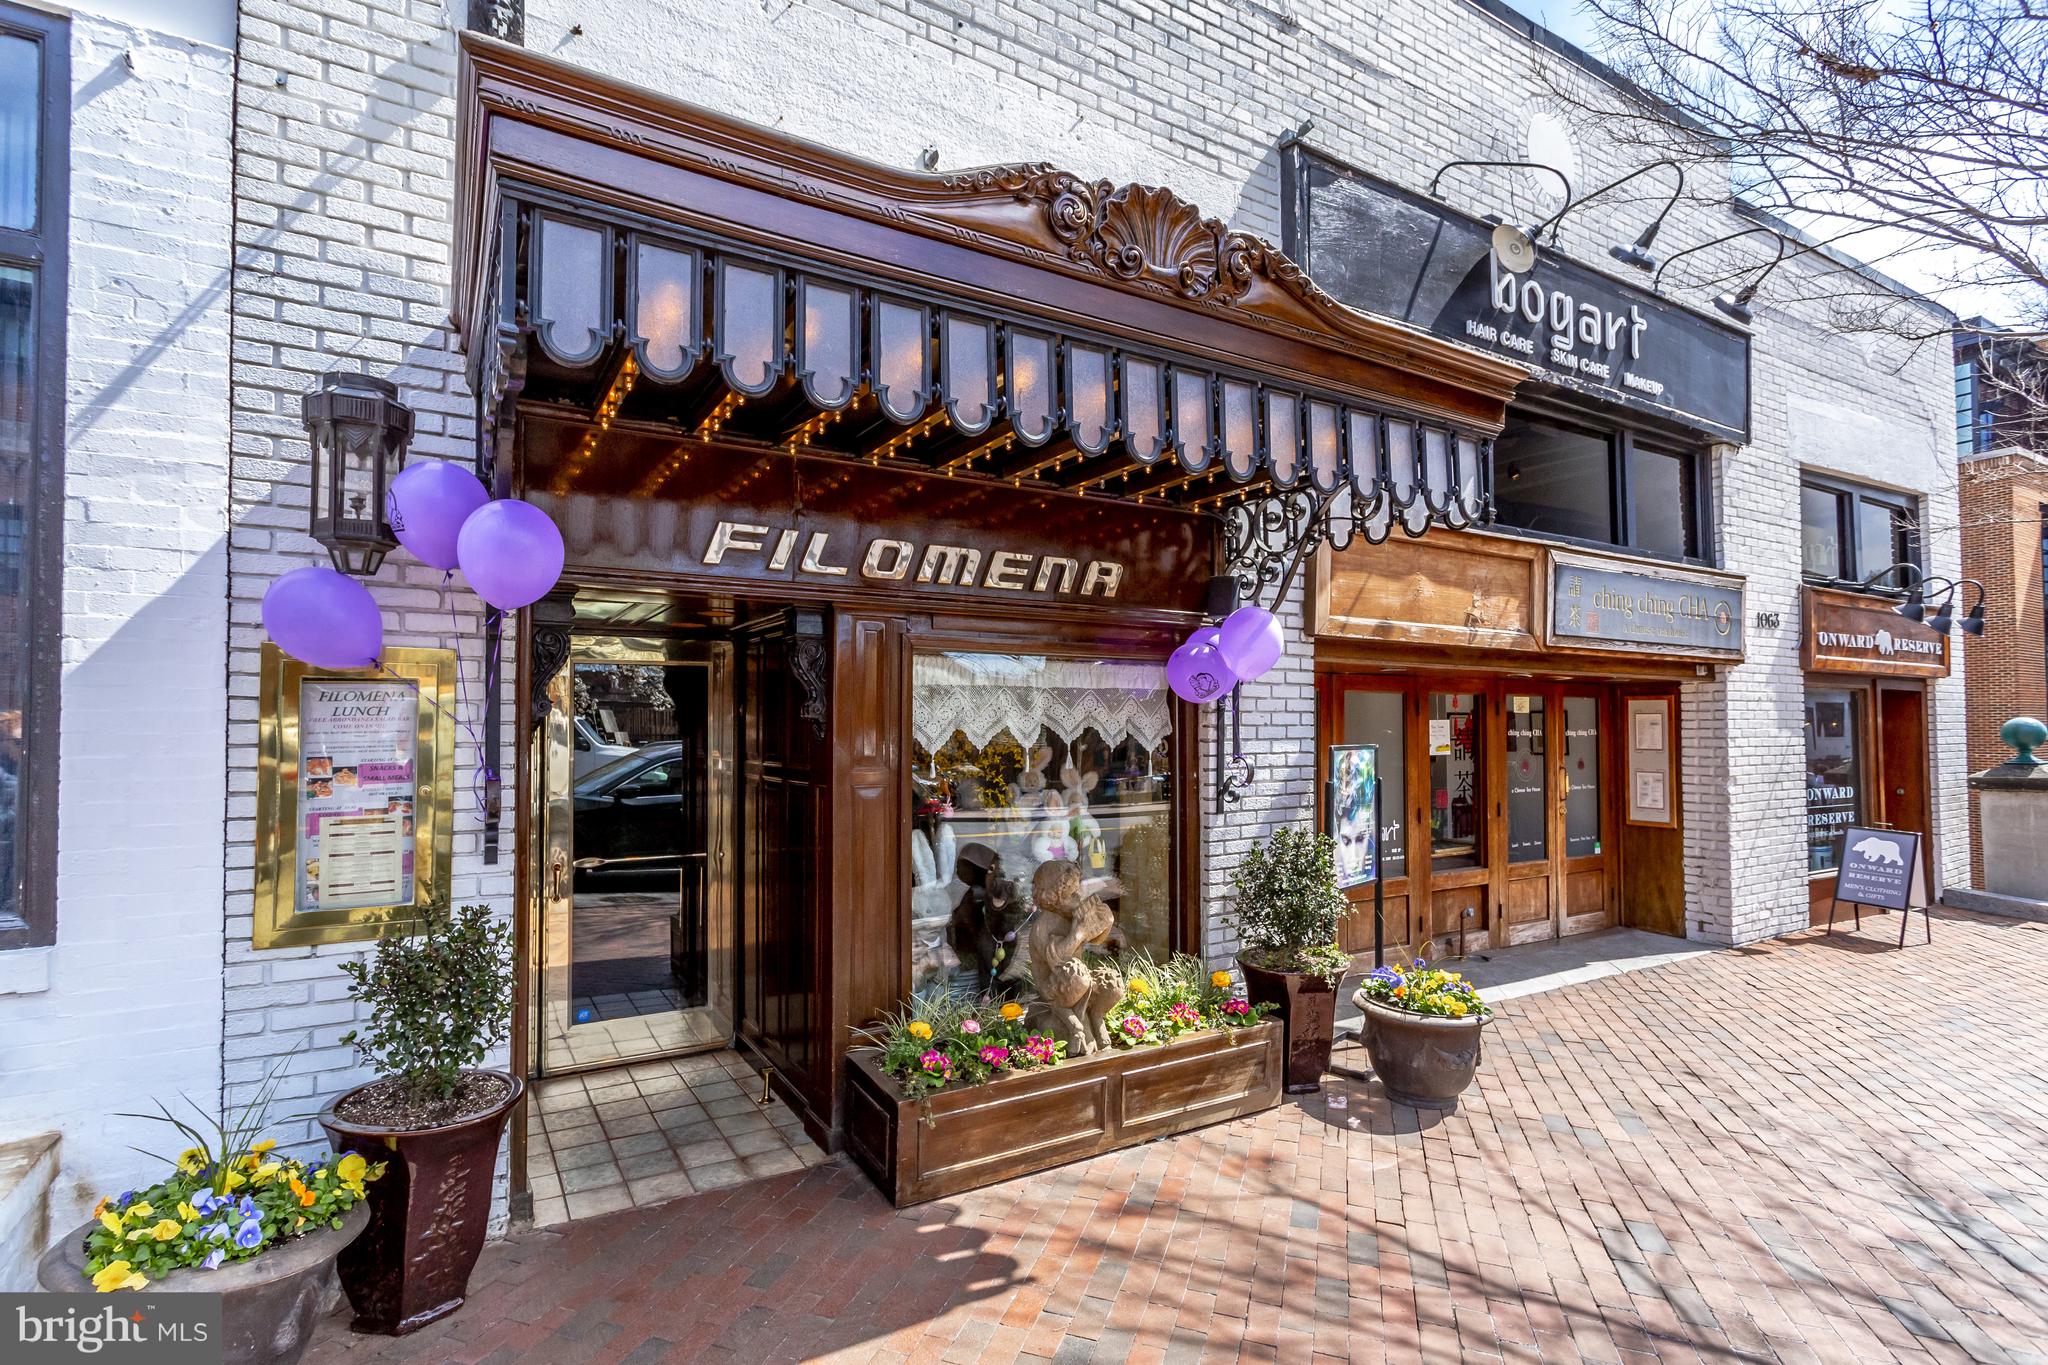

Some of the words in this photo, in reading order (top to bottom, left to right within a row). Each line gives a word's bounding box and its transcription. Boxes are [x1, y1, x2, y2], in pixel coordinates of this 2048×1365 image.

[1489, 247, 1648, 359] bogart
[1466, 319, 1497, 342] HAIR
[1500, 331, 1534, 354] CARE
[1550, 348, 1578, 369] SKIN
[1579, 358, 1611, 379] CARE
[1623, 372, 1664, 396] MAKEUP
[702, 520, 1125, 598] FILOMENA
[1593, 584, 1634, 619] ching
[1637, 591, 1675, 624] ching
[1678, 594, 1710, 621] CHA
[1756, 612, 1780, 629] 1063
[1818, 631, 1874, 649] ONWARD
[1894, 637, 1943, 655] RESERVE
[318, 690, 406, 702] FILOMENA
[331, 706, 391, 717] LUNCH
[1507, 728, 1520, 737] ching
[1520, 729, 1532, 737] ching
[1807, 786, 1854, 801] ONWARD
[1807, 811, 1855, 826] RESERVE
[1849, 862, 1903, 874] ONWARD
[1848, 872, 1902, 885] RESERVE
[1865, 884, 1902, 896] CLOTHING
[1865, 892, 1885, 900] GIFTS
